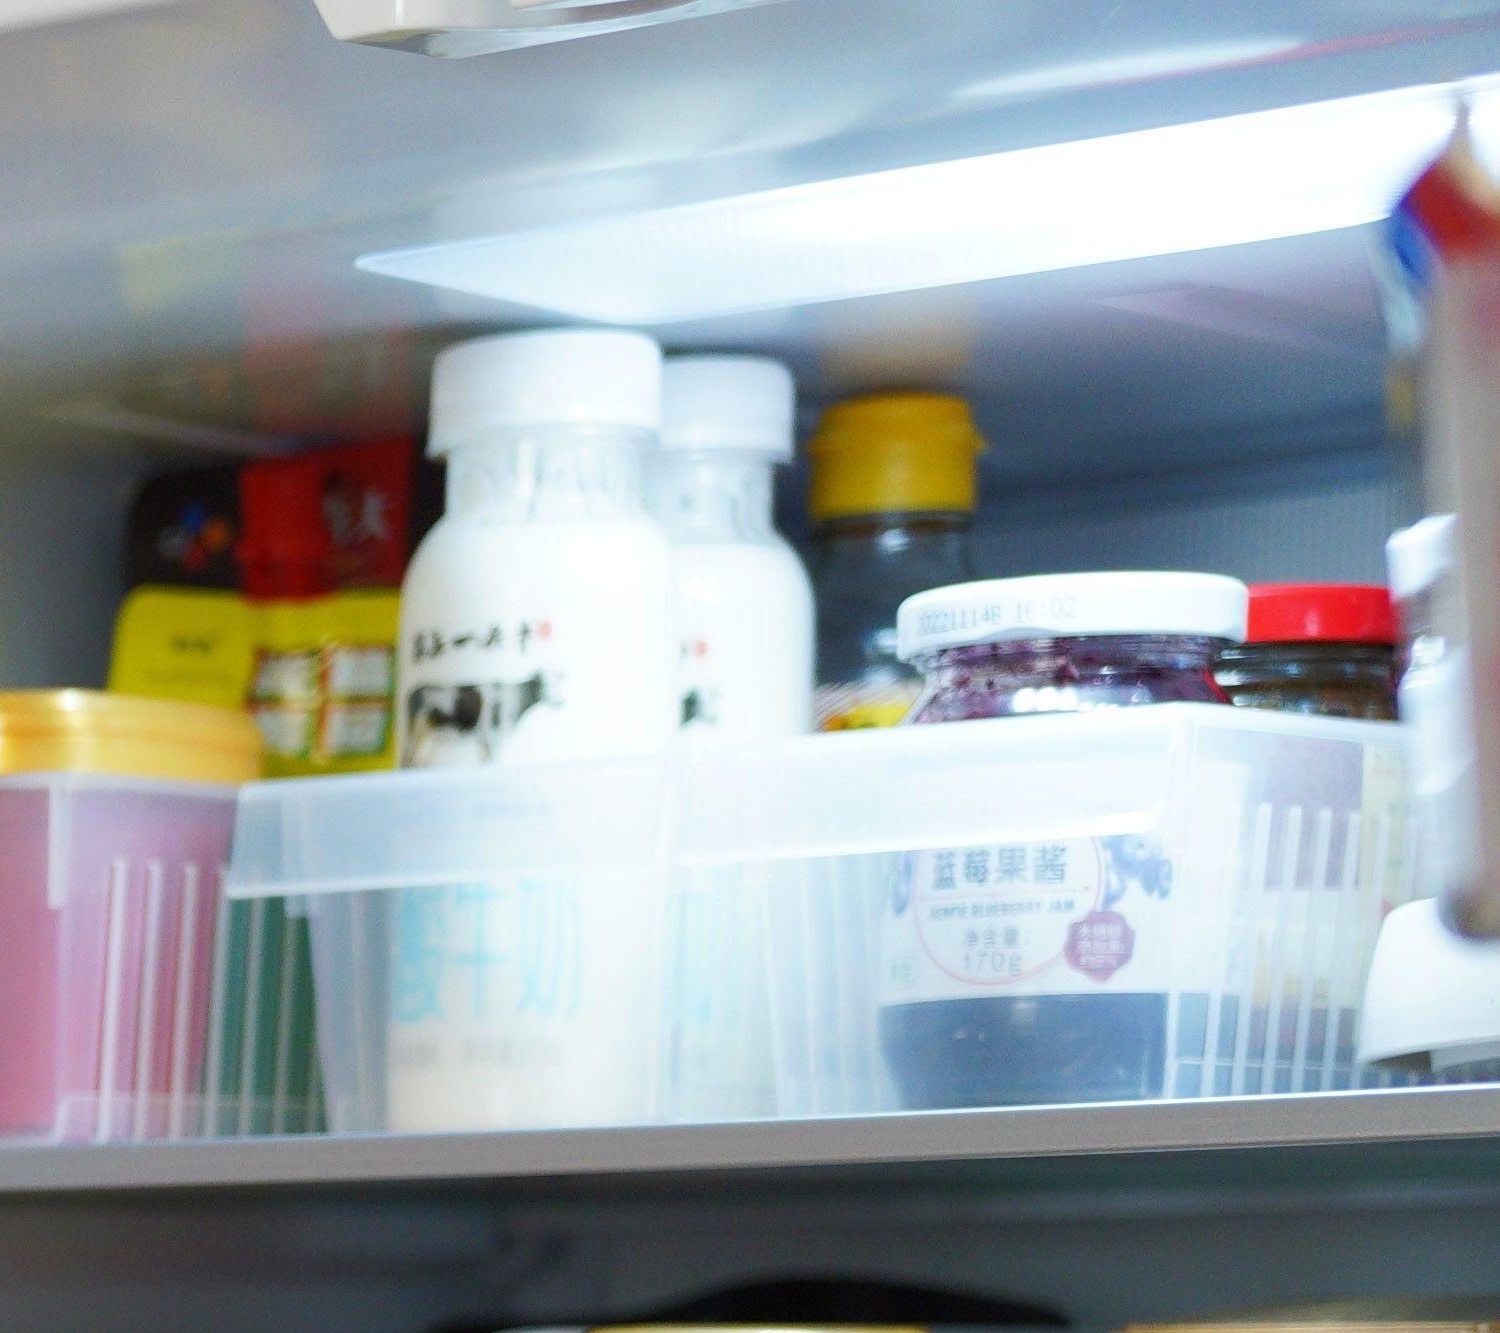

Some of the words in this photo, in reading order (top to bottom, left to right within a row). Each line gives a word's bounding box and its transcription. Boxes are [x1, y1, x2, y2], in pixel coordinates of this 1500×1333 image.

[932, 845, 1068, 890] 蓝莓果酱
[1048, 898, 1075, 914] JAM
[964, 950, 1023, 977] 170g
